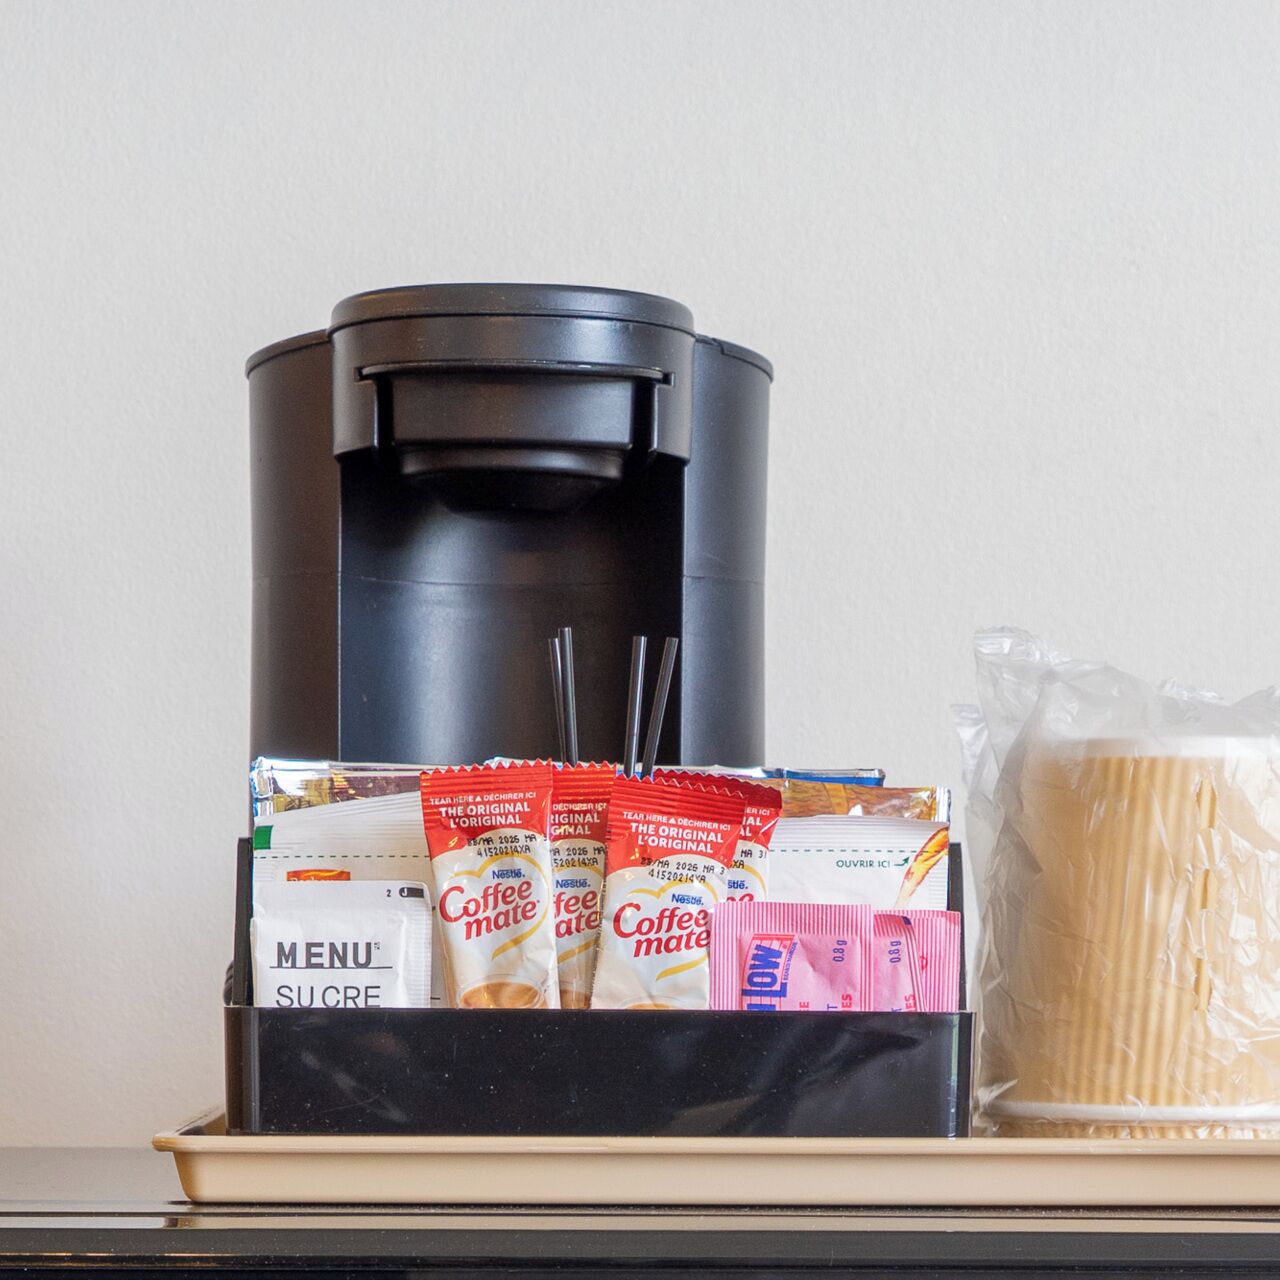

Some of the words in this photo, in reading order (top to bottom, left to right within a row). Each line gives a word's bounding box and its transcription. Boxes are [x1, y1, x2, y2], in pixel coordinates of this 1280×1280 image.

[430, 797, 452, 805] TEAR
[453, 795, 474, 803] HERE
[439, 806, 464, 817] THE
[467, 801, 531, 816] ORIGINAL
[449, 814, 522, 829] L'ORIGINAL
[623, 811, 644, 820] TEAR
[645, 814, 667, 823] HERE
[720, 823, 731, 831] ICI
[630, 823, 656, 834] THE
[658, 826, 724, 842] ORIGINAL
[638, 835, 713, 853] L'ORIGINAL
[836, 860, 874, 868] OUVRIR
[439, 880, 532, 923] Coffee
[464, 900, 538, 941] mate
[555, 910, 601, 938] ate
[613, 902, 709, 938] Coffee
[634, 929, 710, 957] mate
[276, 941, 372, 968] MENU
[832, 946, 845, 963] 0.8
[889, 948, 902, 964] 0.8
[275, 984, 381, 1008] SUCRE
